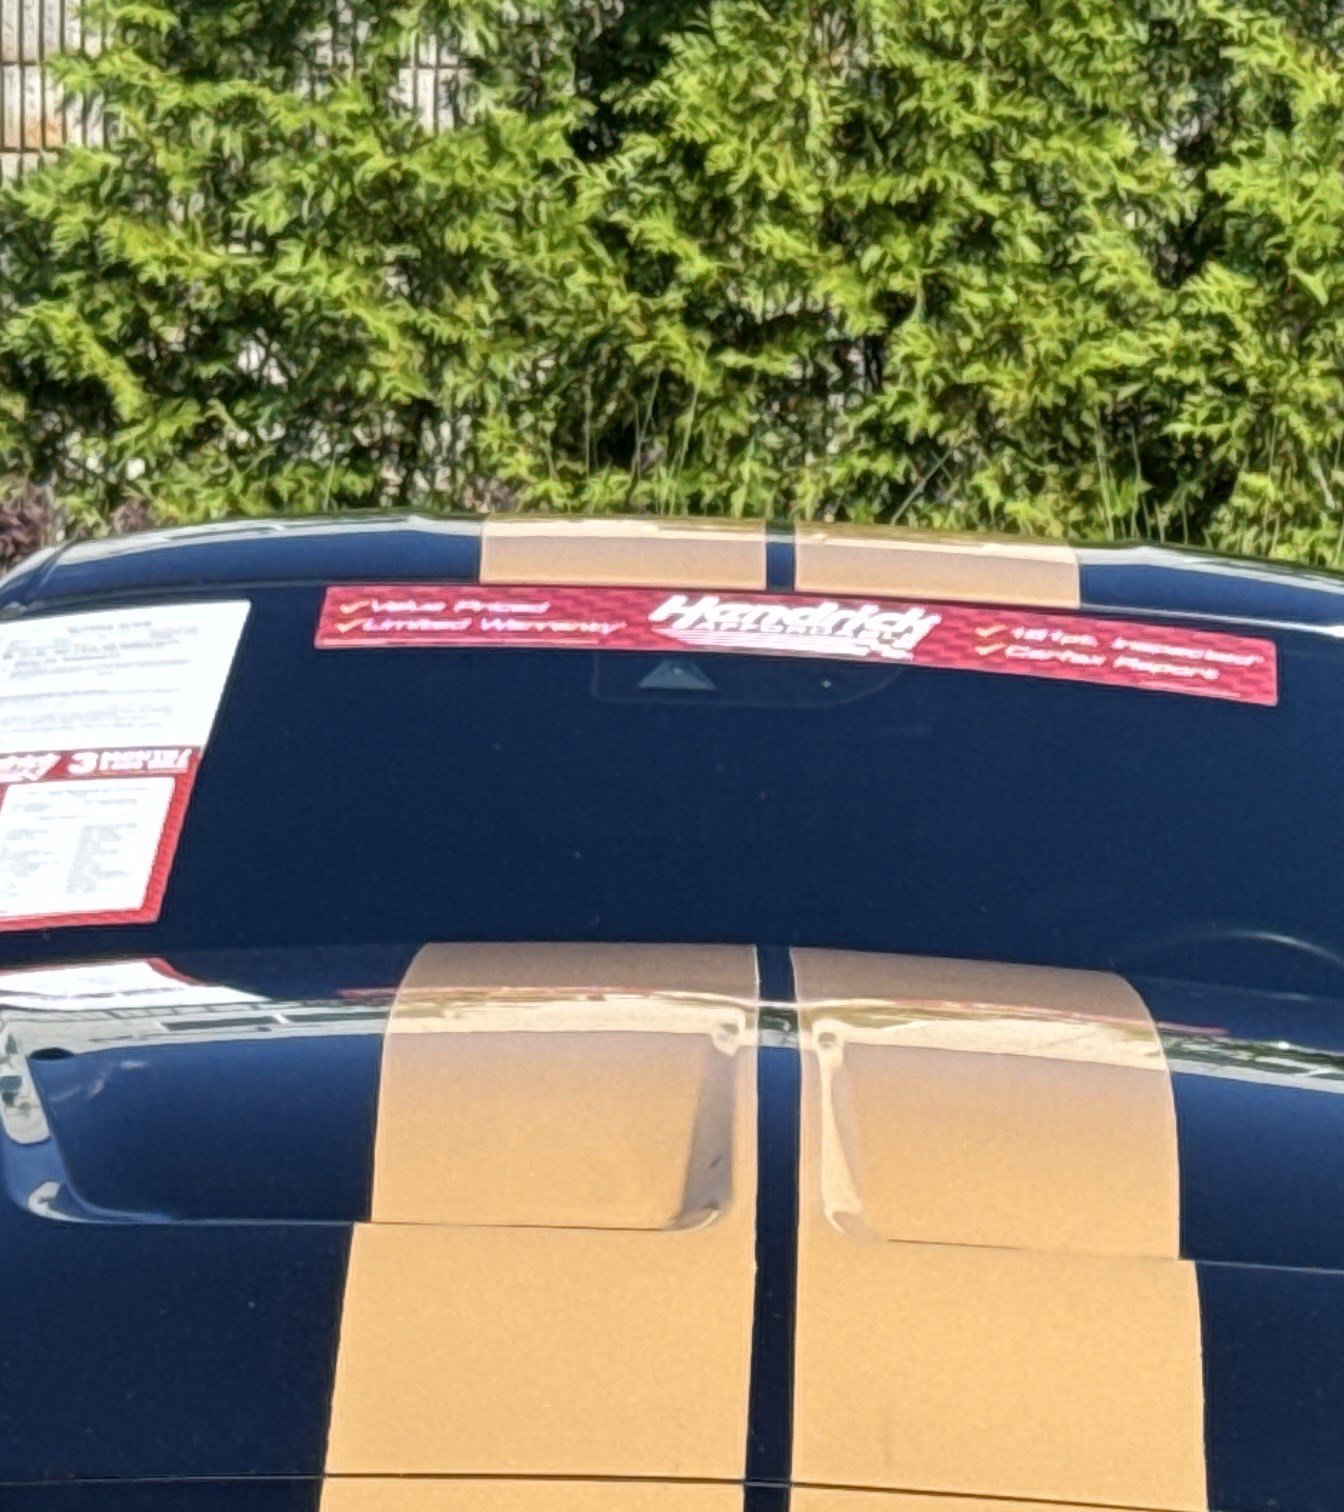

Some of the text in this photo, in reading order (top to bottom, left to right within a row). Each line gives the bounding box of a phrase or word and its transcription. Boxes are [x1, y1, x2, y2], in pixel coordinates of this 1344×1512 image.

[453, 599, 550, 614] Priced
[362, 616, 627, 635] Limited Warranty
[648, 595, 942, 650] Hendrick
